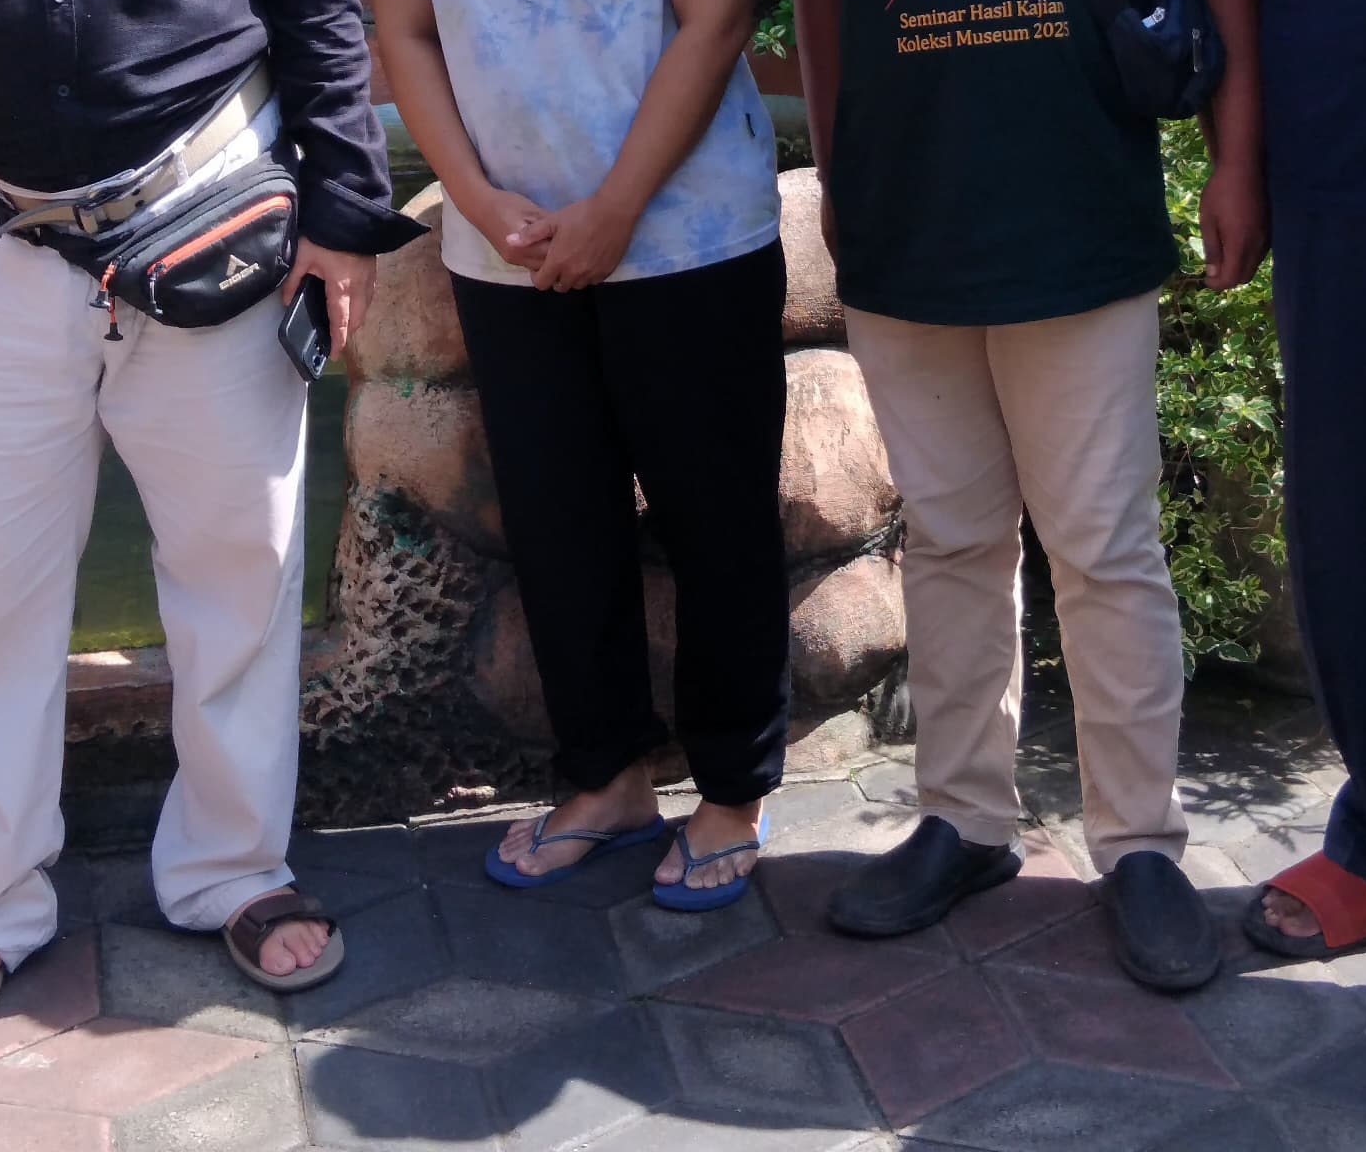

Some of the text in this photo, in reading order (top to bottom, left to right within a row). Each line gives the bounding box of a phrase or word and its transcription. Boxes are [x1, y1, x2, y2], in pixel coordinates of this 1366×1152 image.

[899, 9, 967, 29] Seminar
[970, 0, 1013, 21] Hasil
[896, 32, 952, 54] Koleksi
[956, 27, 1030, 46] Museum
